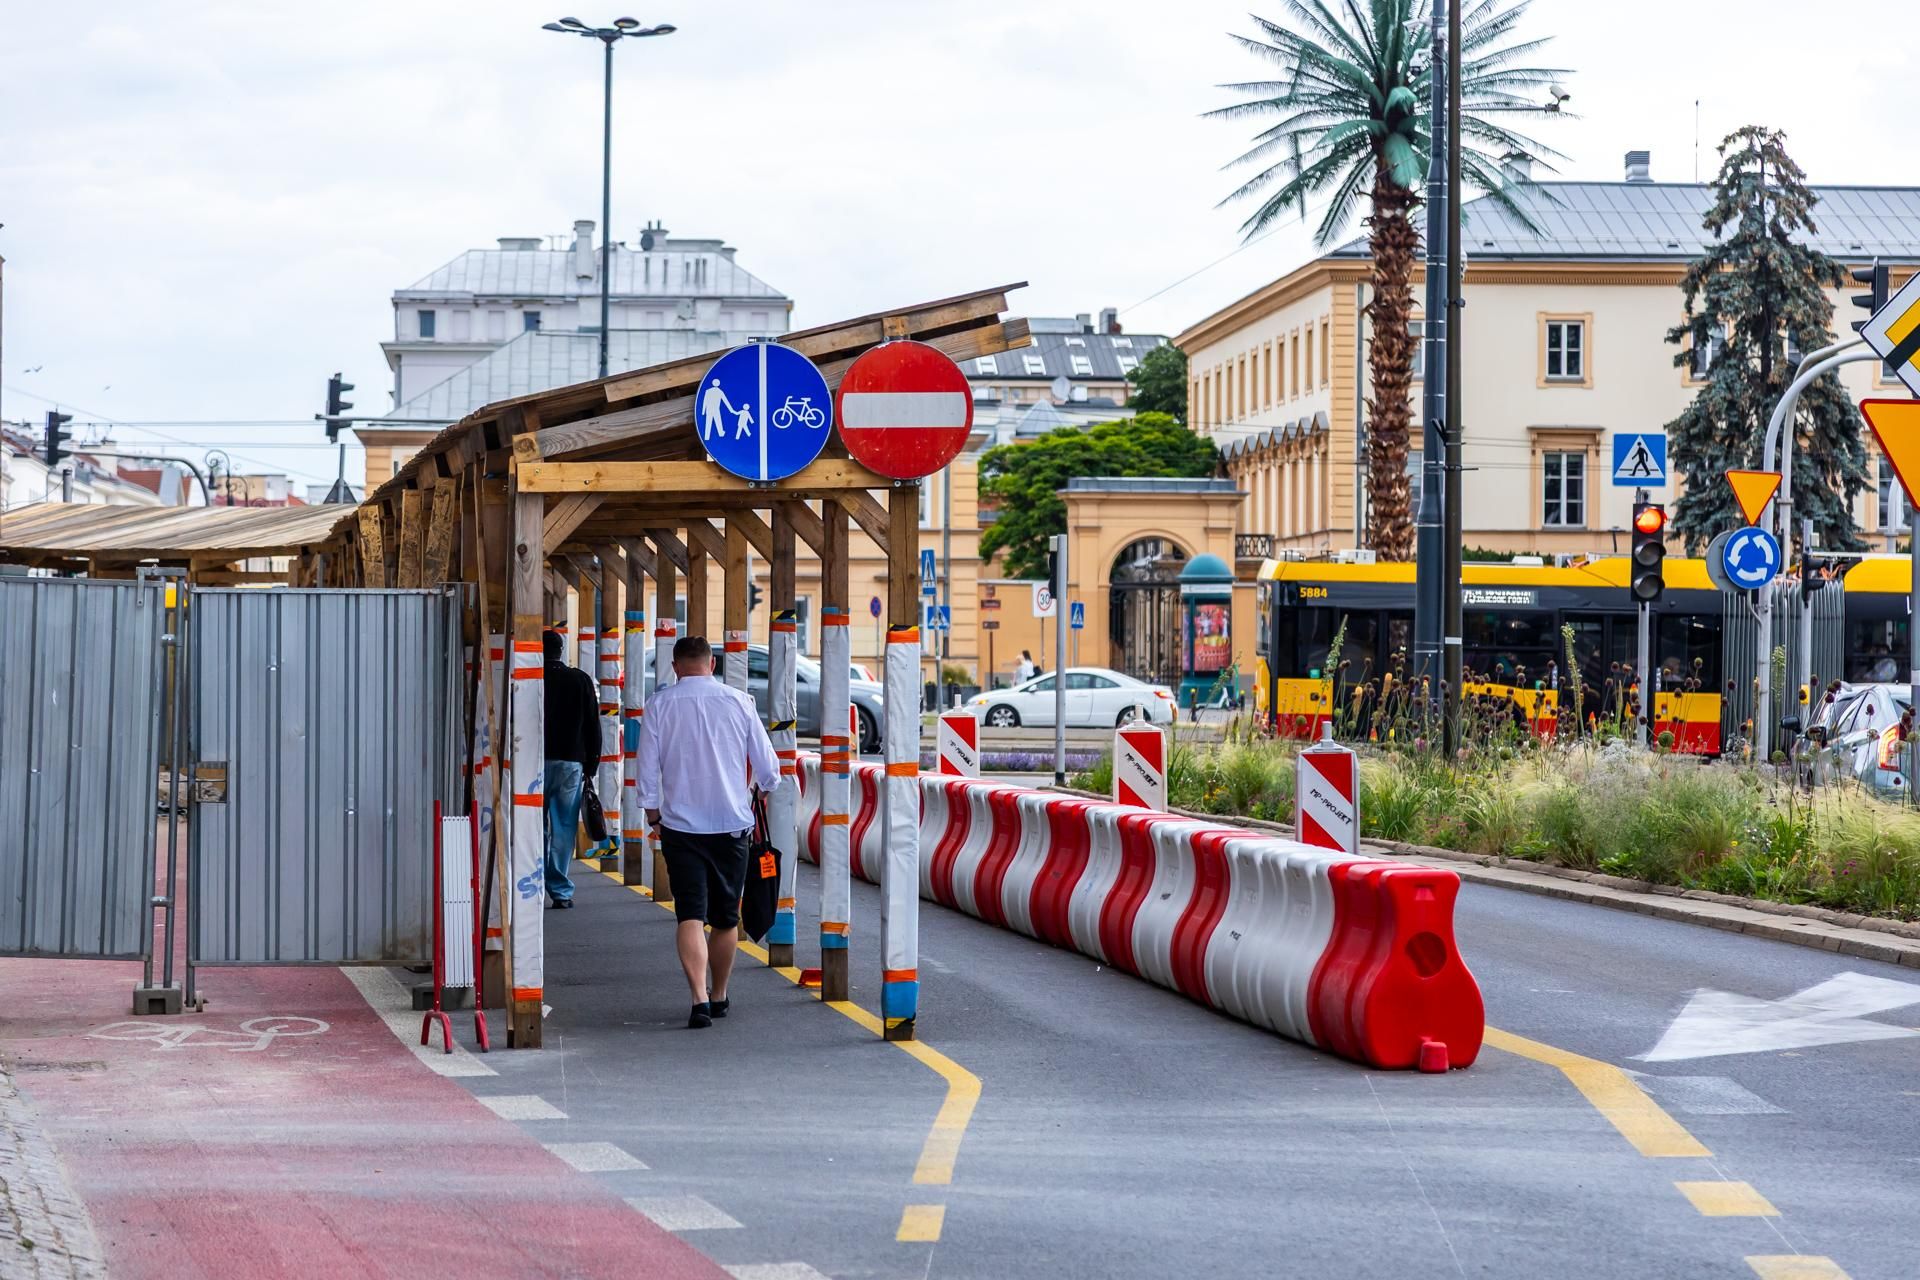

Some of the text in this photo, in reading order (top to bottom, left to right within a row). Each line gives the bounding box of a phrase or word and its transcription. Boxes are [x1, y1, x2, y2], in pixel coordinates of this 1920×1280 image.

[1040, 593, 1050, 605] 30
[1299, 586, 1328, 599] 5884
[1125, 752, 1158, 787] MP-PROJEKT
[1310, 788, 1353, 825] MP-PROJEKT
